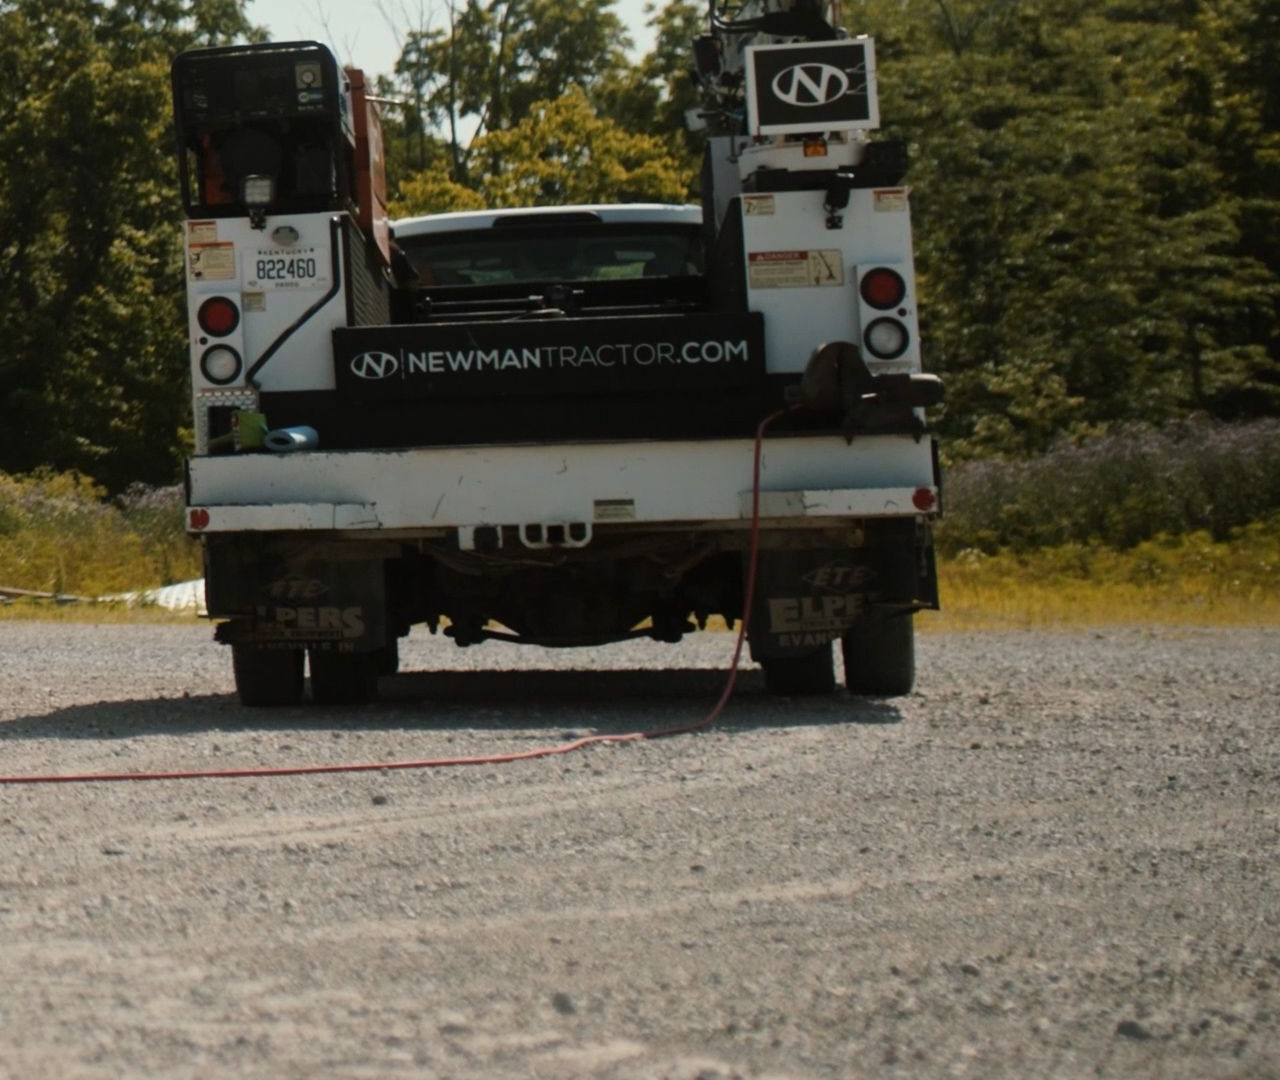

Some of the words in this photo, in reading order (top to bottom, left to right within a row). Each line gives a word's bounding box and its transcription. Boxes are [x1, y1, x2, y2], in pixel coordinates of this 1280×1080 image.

[263, 248, 308, 256] KENTUCKY
[256, 258, 316, 280] 822460
[408, 341, 749, 374] NEWMANTRACTOR.COM
